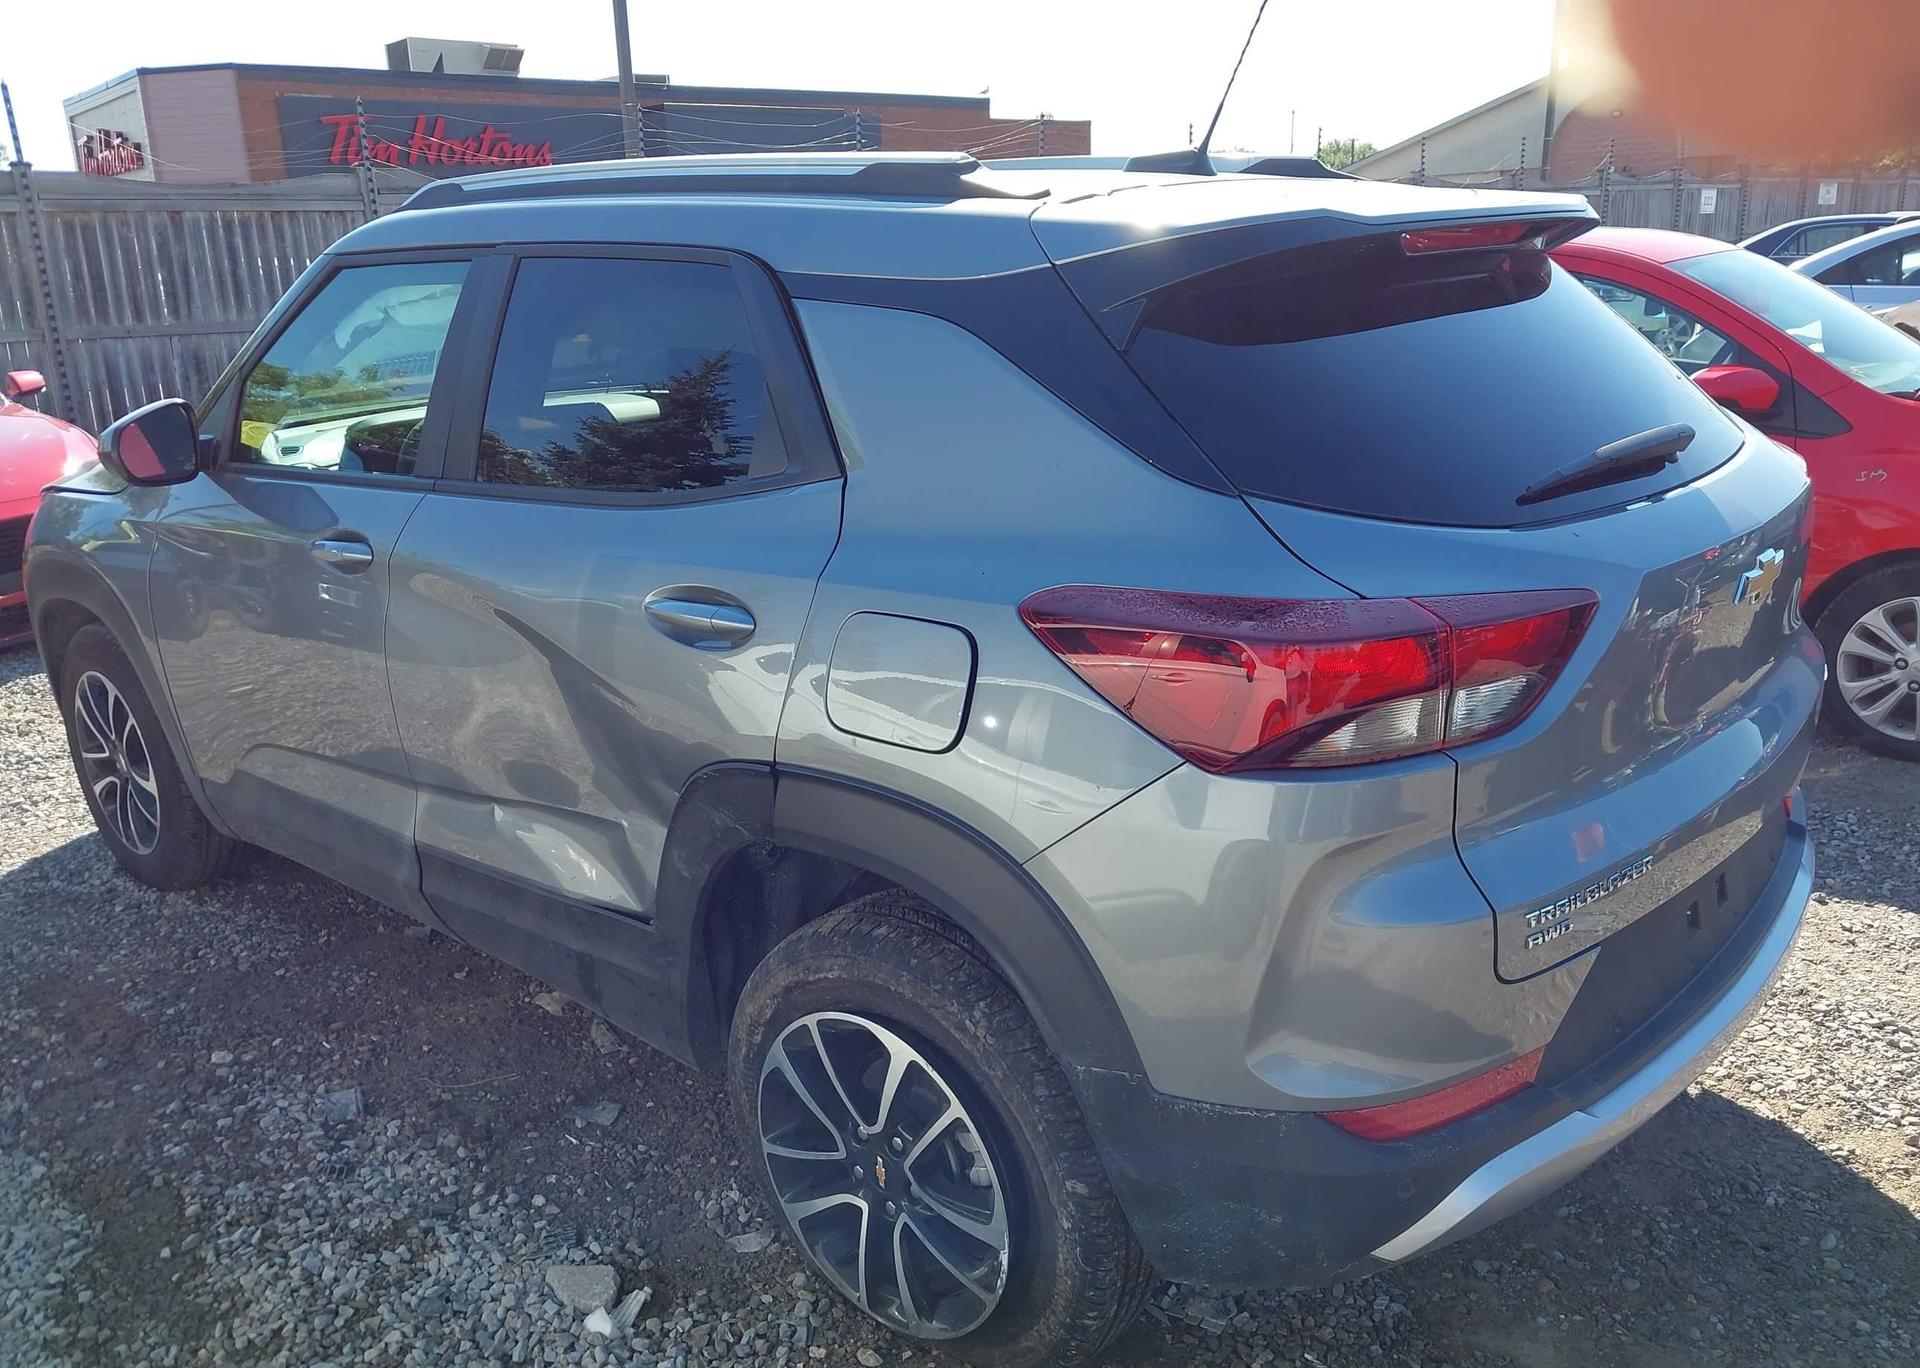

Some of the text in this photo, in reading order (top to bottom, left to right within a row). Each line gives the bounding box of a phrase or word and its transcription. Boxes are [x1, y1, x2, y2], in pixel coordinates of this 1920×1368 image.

[320, 112, 553, 166] Tim Hortons
[1524, 855, 1654, 928] TRAILBLAZER
[1526, 918, 1574, 949] AWD
